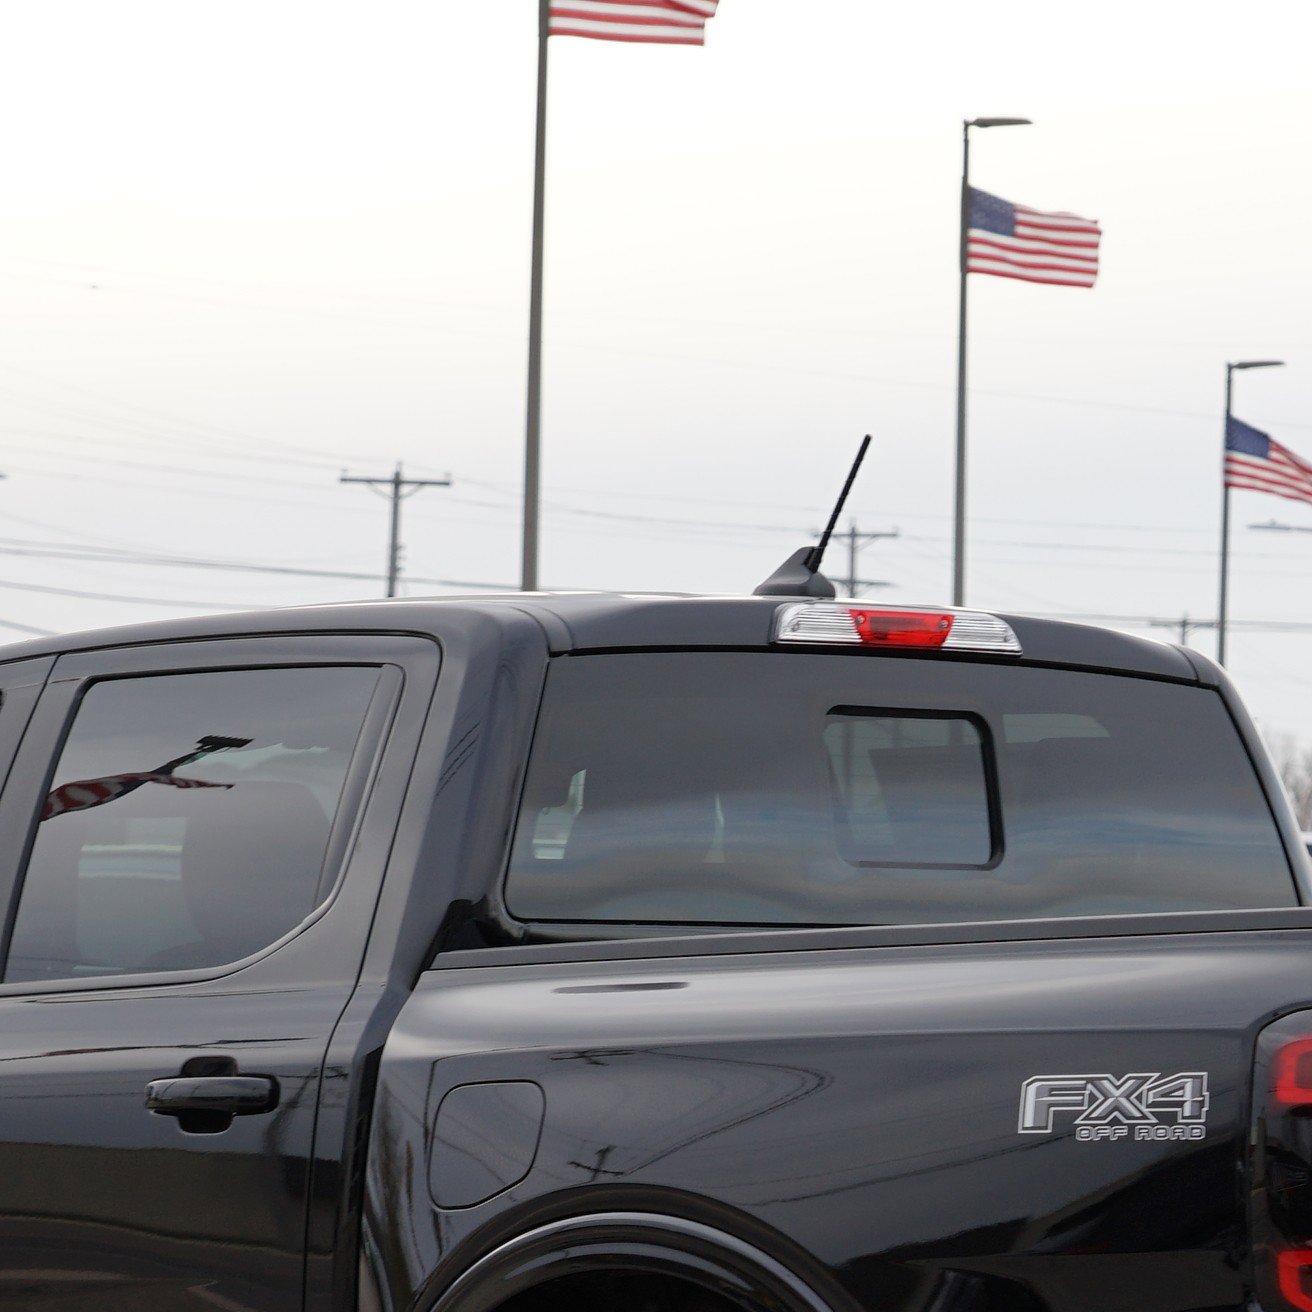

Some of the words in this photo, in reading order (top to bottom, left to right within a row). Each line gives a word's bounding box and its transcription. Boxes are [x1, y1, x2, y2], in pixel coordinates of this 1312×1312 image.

[1018, 1071, 1210, 1134] FX4
[1075, 1125, 1129, 1142] OFF
[1134, 1124, 1207, 1142] ROAD
